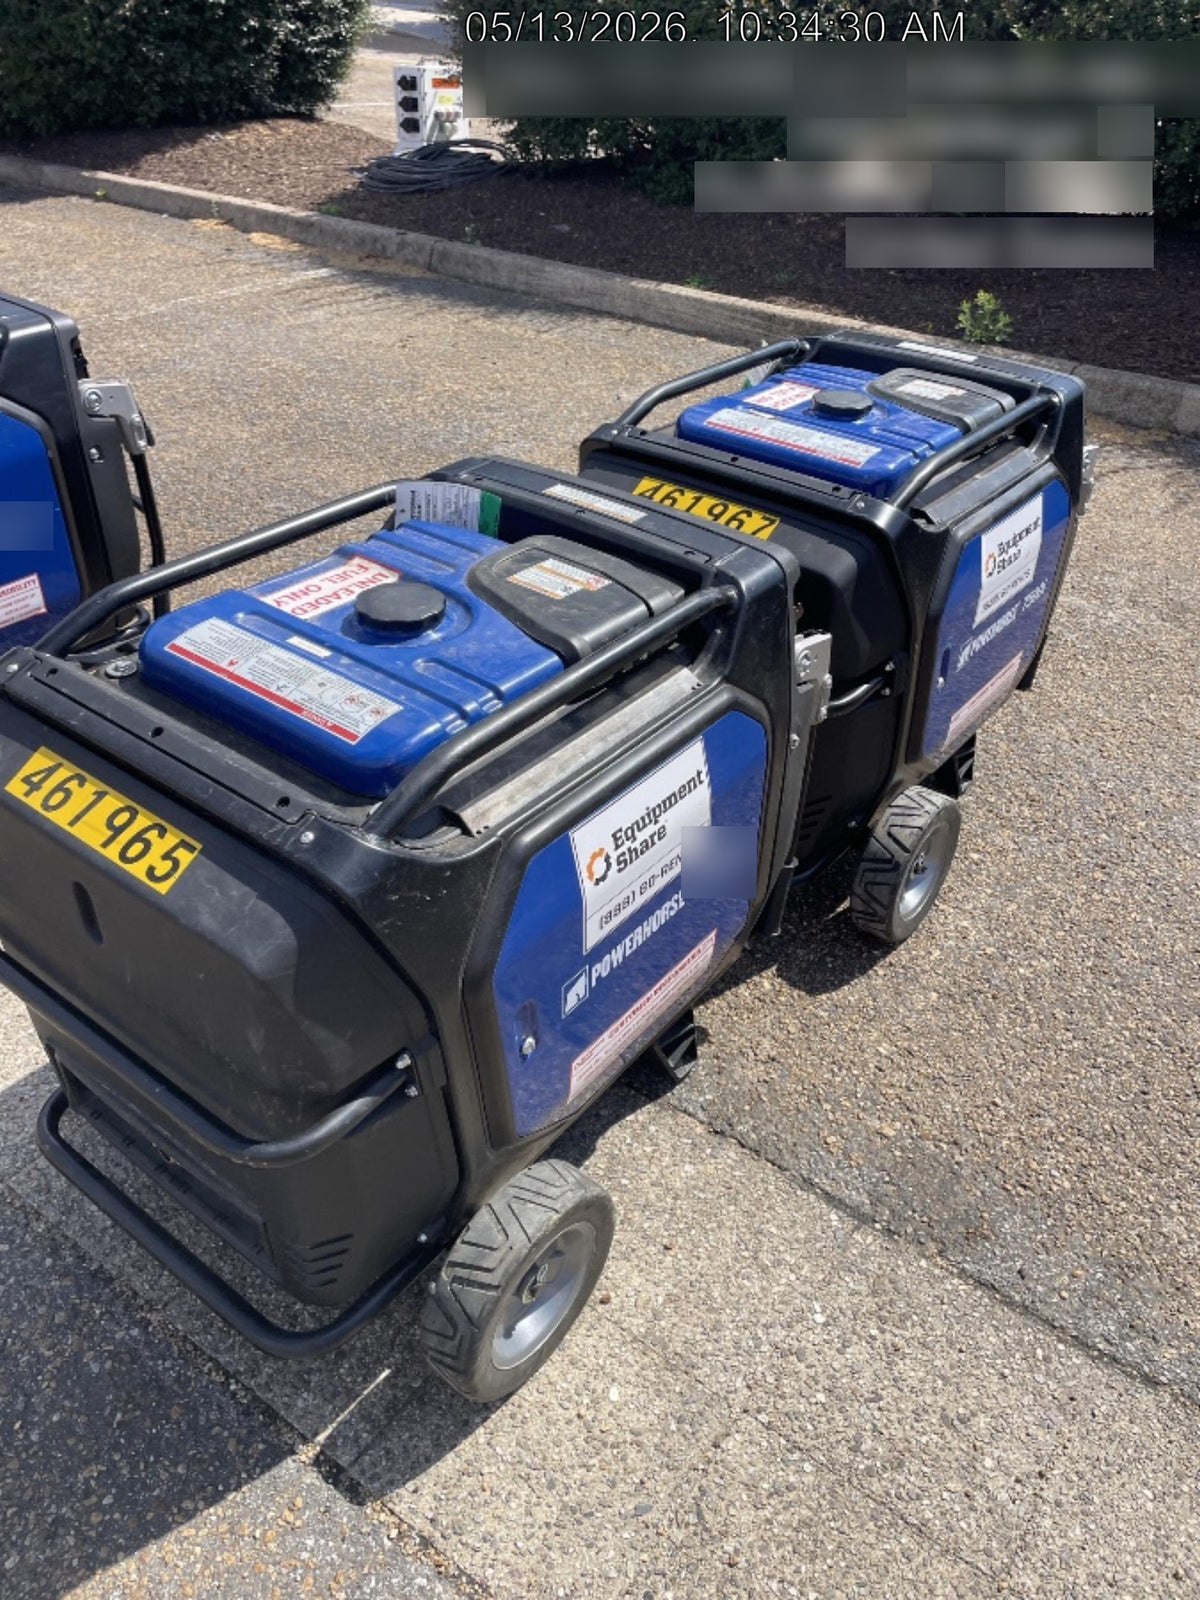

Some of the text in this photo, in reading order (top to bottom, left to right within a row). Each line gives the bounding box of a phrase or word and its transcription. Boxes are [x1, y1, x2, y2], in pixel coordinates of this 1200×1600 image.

[638, 482, 776, 537] 461967
[273, 562, 369, 608] FUEL ONLY
[290, 570, 390, 617] UNLEADED
[20, 761, 199, 884] 461965
[610, 768, 705, 852] Equipment
[615, 823, 668, 874] Share
